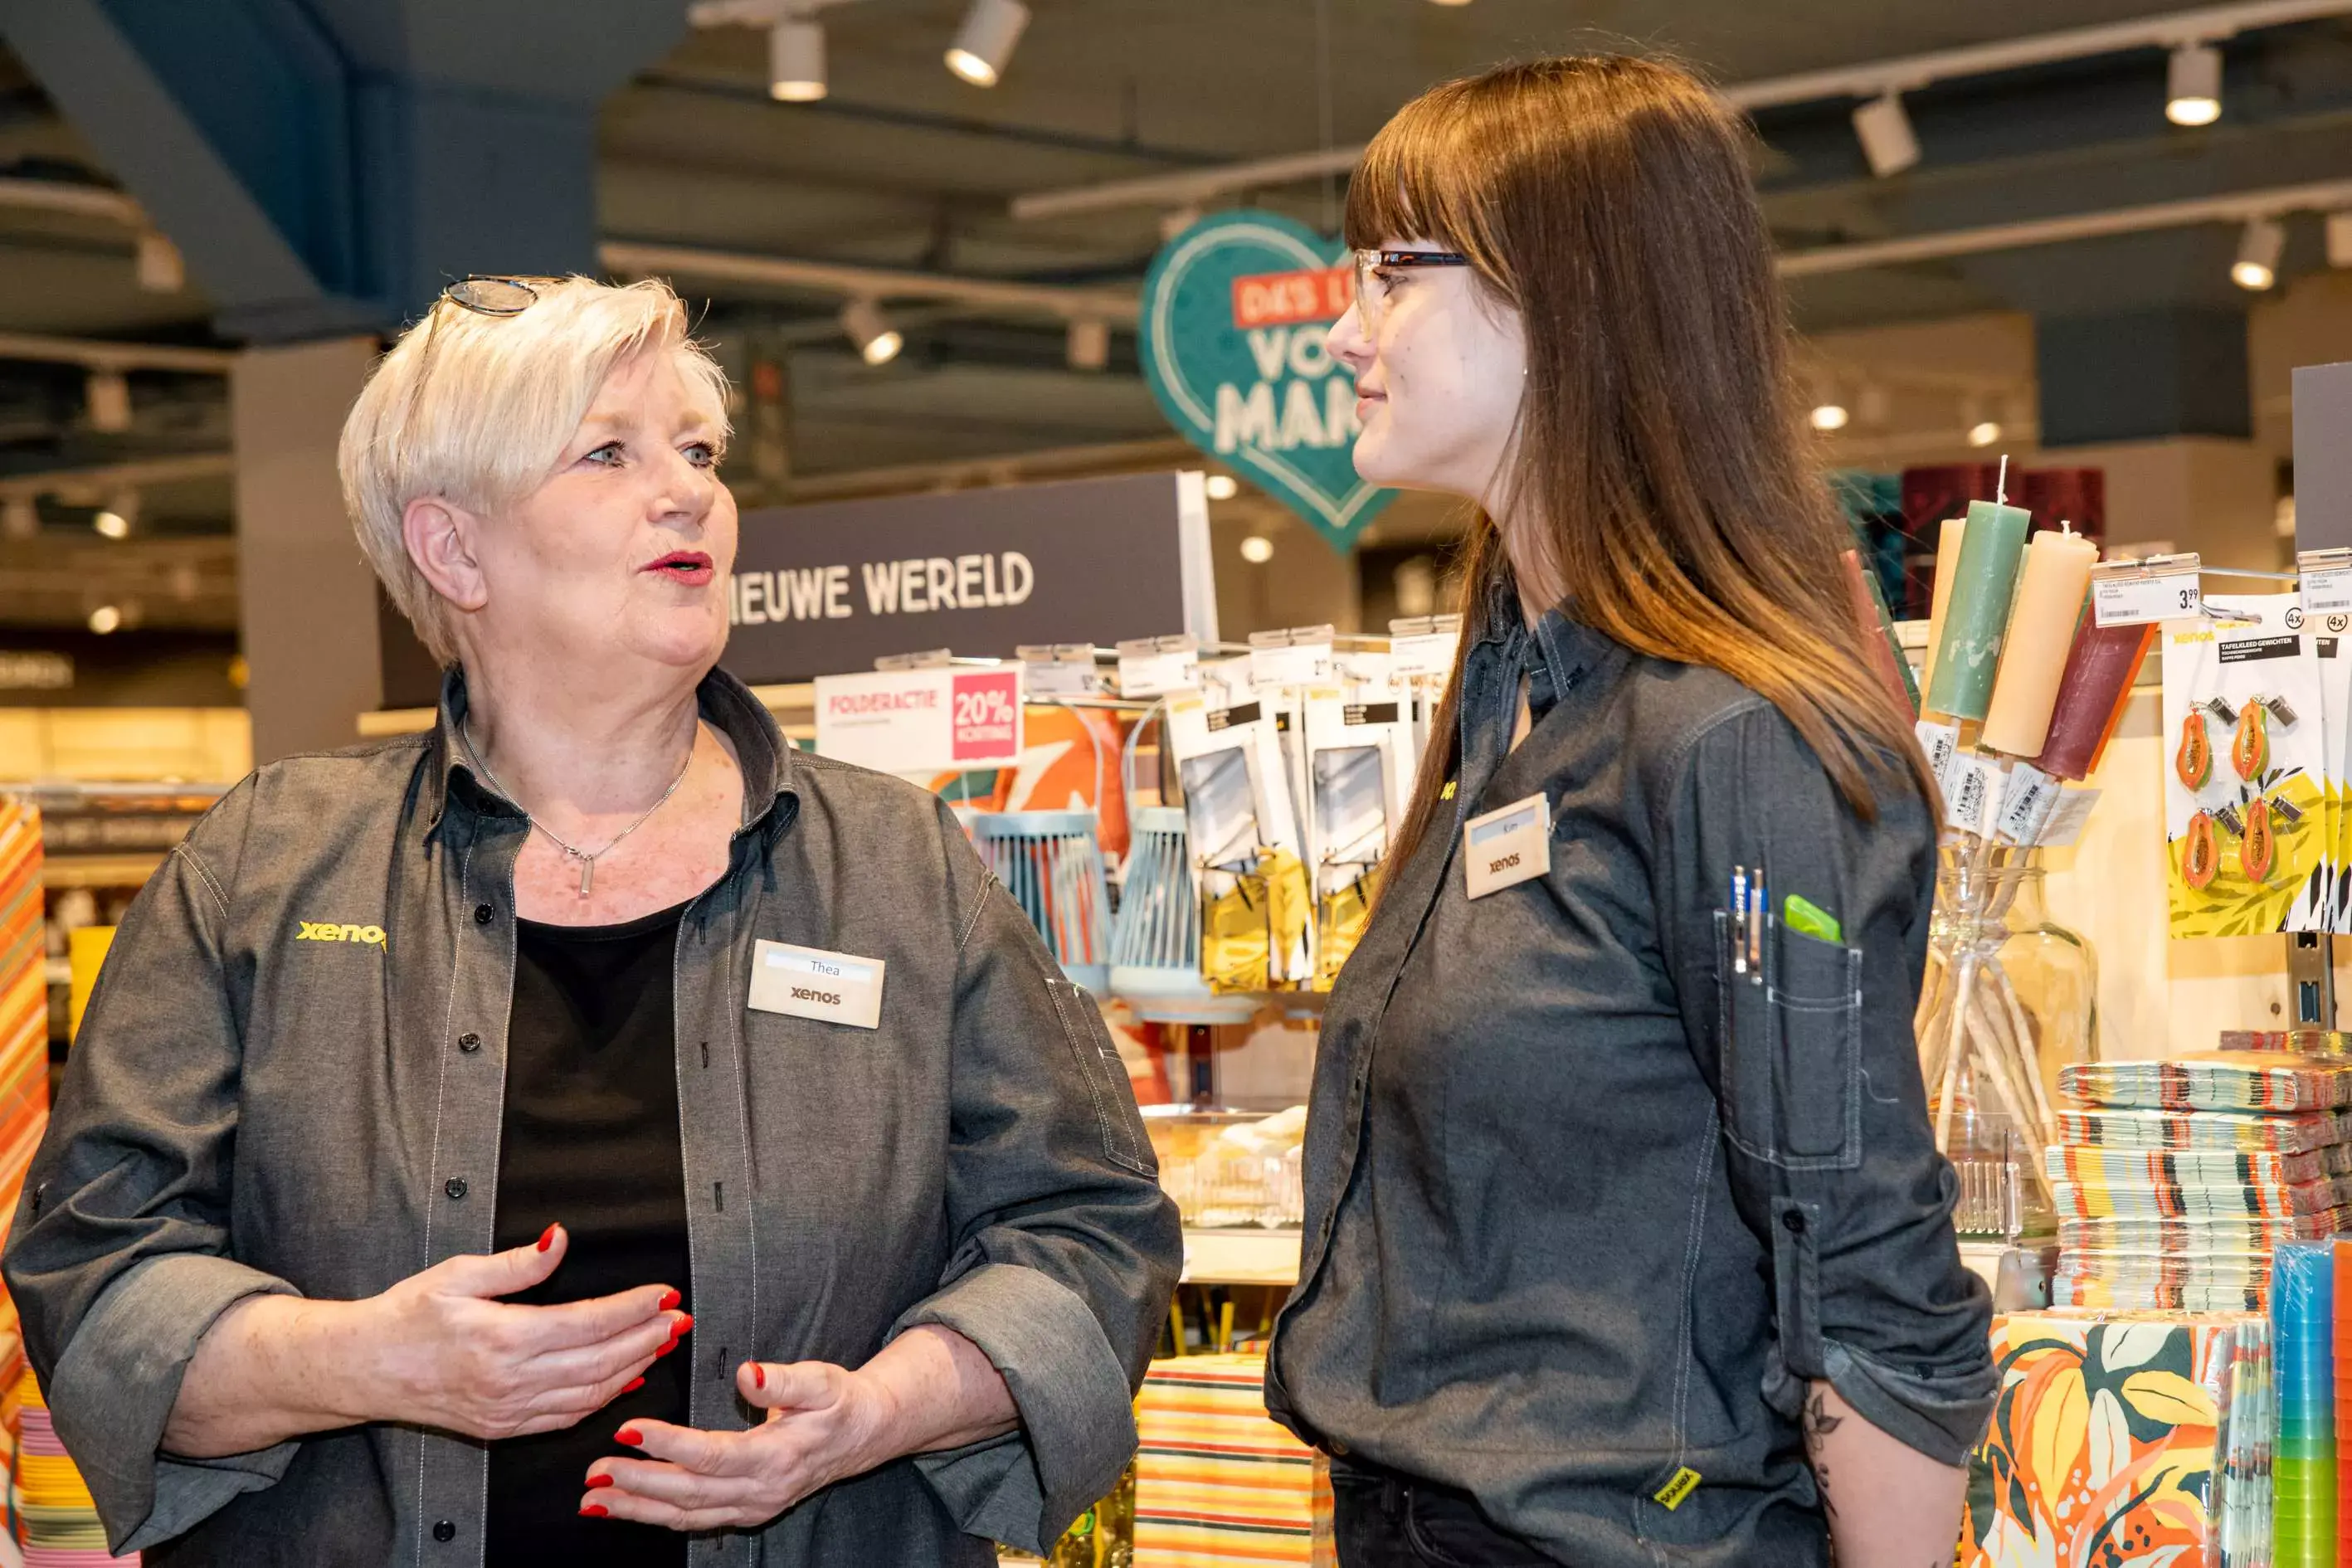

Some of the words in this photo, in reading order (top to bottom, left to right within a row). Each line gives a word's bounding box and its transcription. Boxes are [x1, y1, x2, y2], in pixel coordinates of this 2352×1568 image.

[862, 552, 1034, 615] WERELD
[2288, 614, 2301, 624] 4x
[2330, 617, 2344, 626] 4x
[2221, 641, 2257, 650] TAFELKLEED
[2257, 637, 2292, 647] GEWICHTEN
[830, 689, 938, 714] FOLDERACTIE
[955, 689, 1015, 725] 20%
[1489, 853, 1520, 874] xenos
[808, 960, 841, 976] Thea
[790, 986, 842, 1006] xenos
